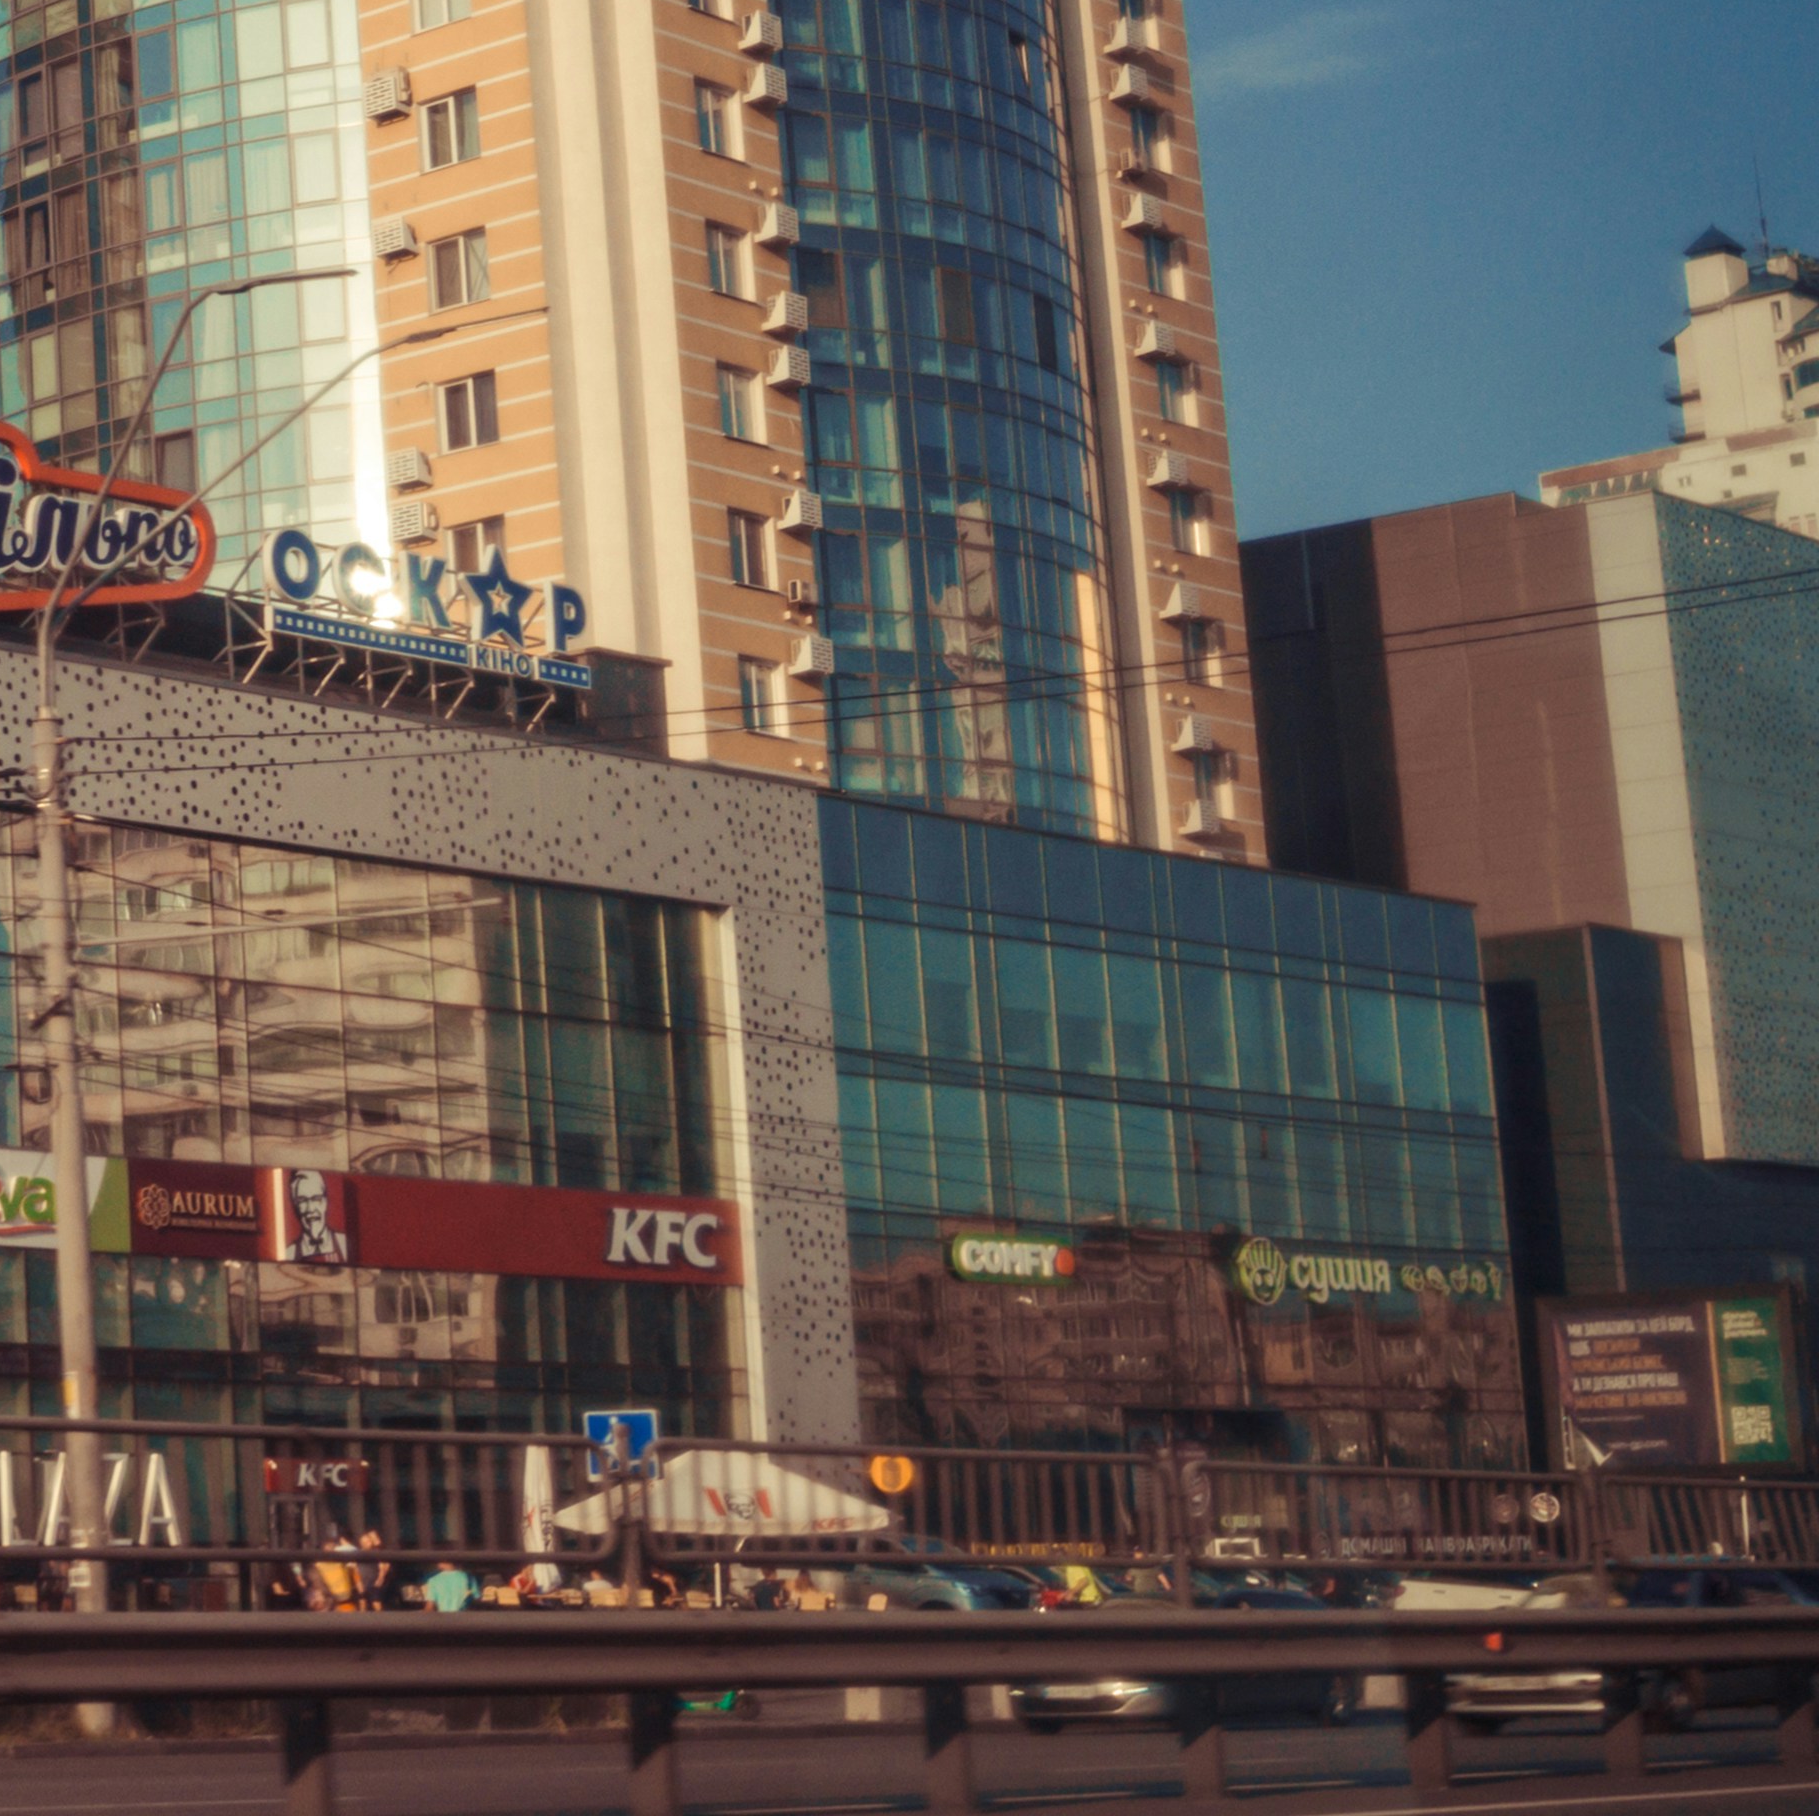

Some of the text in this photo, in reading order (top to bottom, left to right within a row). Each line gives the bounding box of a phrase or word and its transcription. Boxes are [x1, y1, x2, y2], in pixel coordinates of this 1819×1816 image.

[475, 647, 533, 677] КІНО
[171, 1191, 255, 1218] AURUM
[606, 1208, 718, 1268] KFC
[961, 1240, 1057, 1277] COMFY
[1290, 1251, 1392, 1303] сушия
[297, 1462, 349, 1488] KFC
